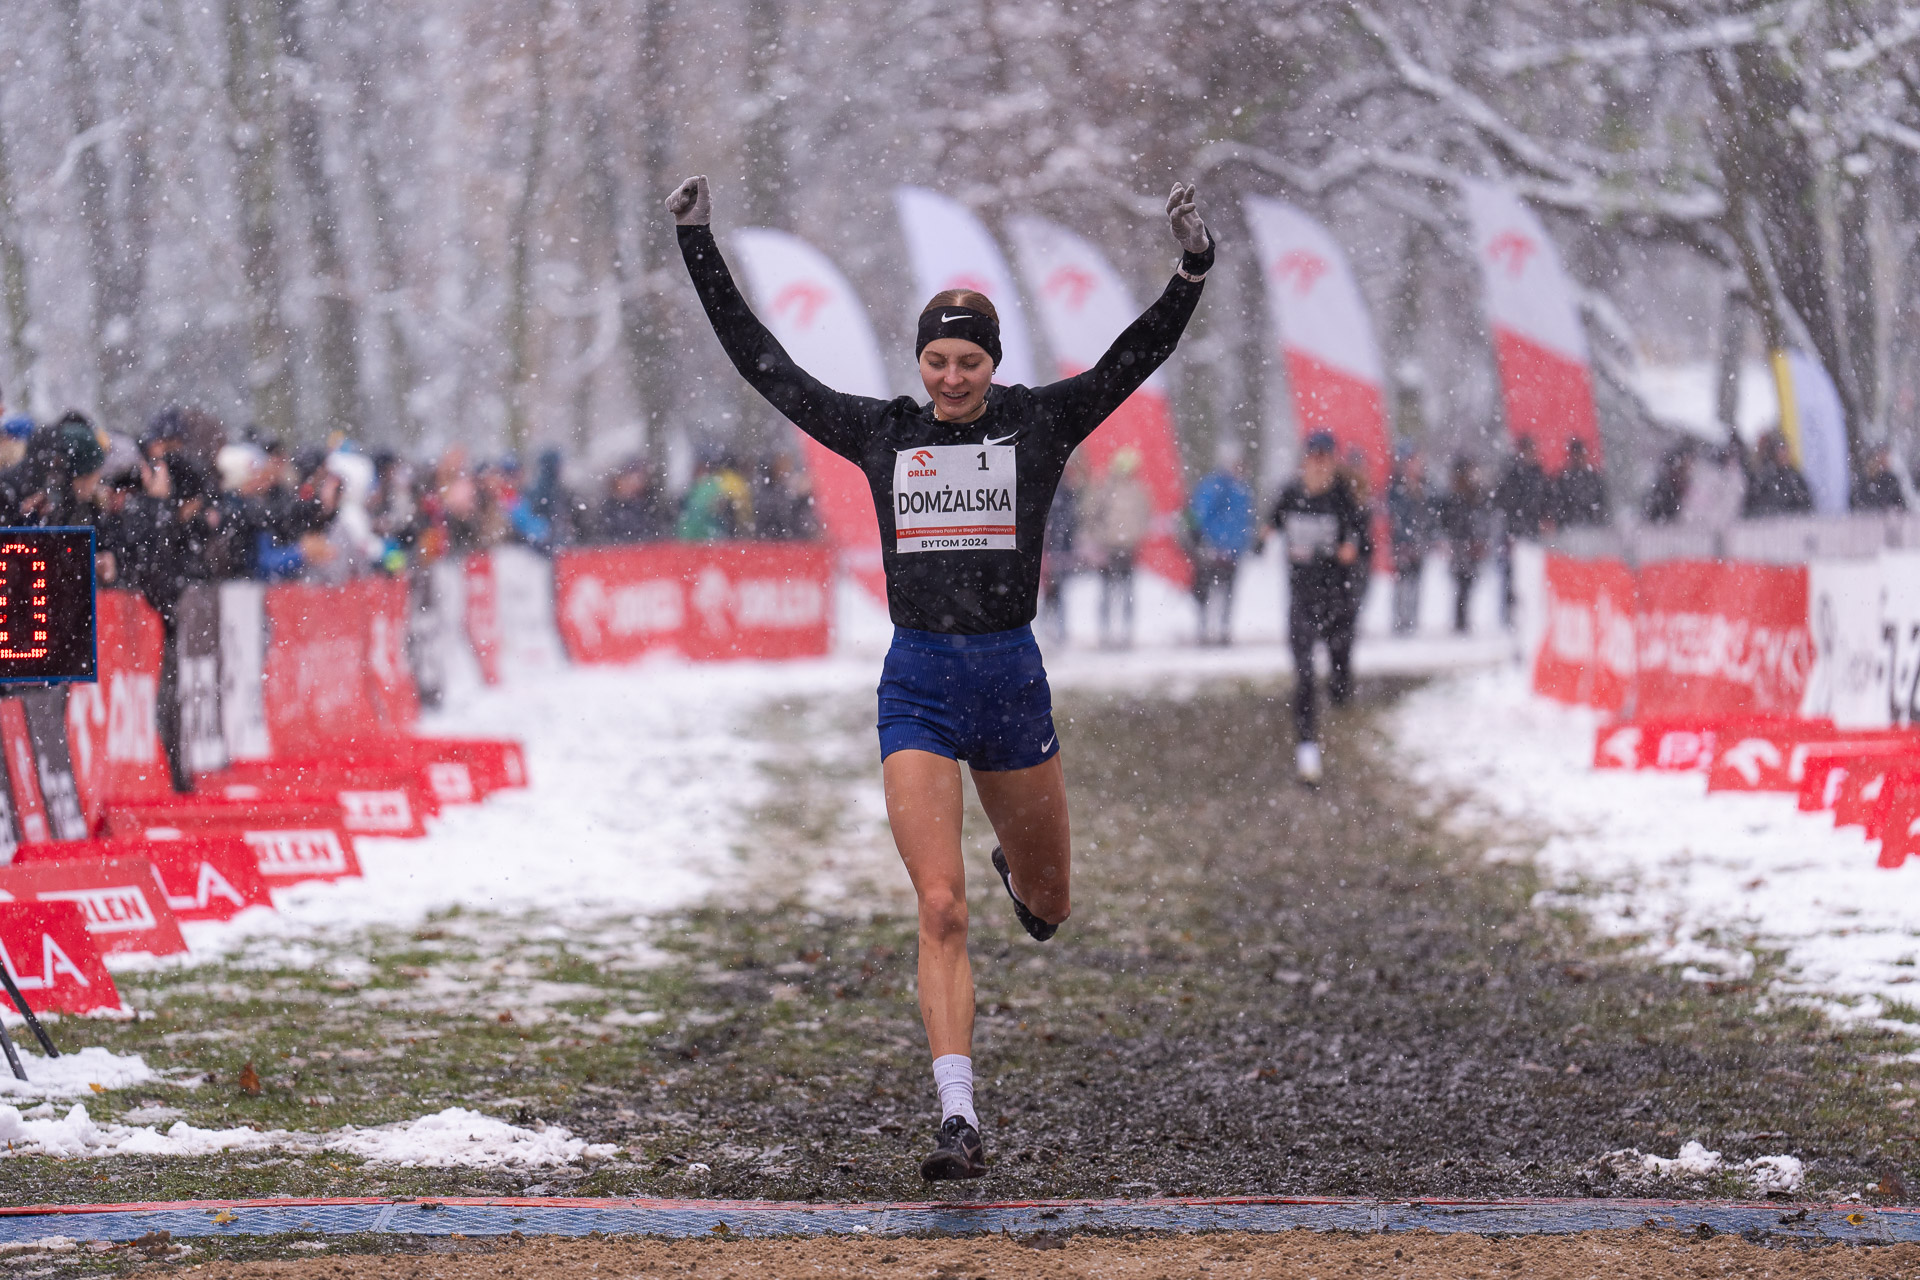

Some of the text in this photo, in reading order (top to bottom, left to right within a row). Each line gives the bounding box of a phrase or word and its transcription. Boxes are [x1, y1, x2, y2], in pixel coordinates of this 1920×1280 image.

[976, 451, 990, 471] 1
[907, 469, 937, 478] ORLEN
[898, 484, 1012, 515] DOMŻALSKA
[921, 538, 988, 549] BYTOM 2024
